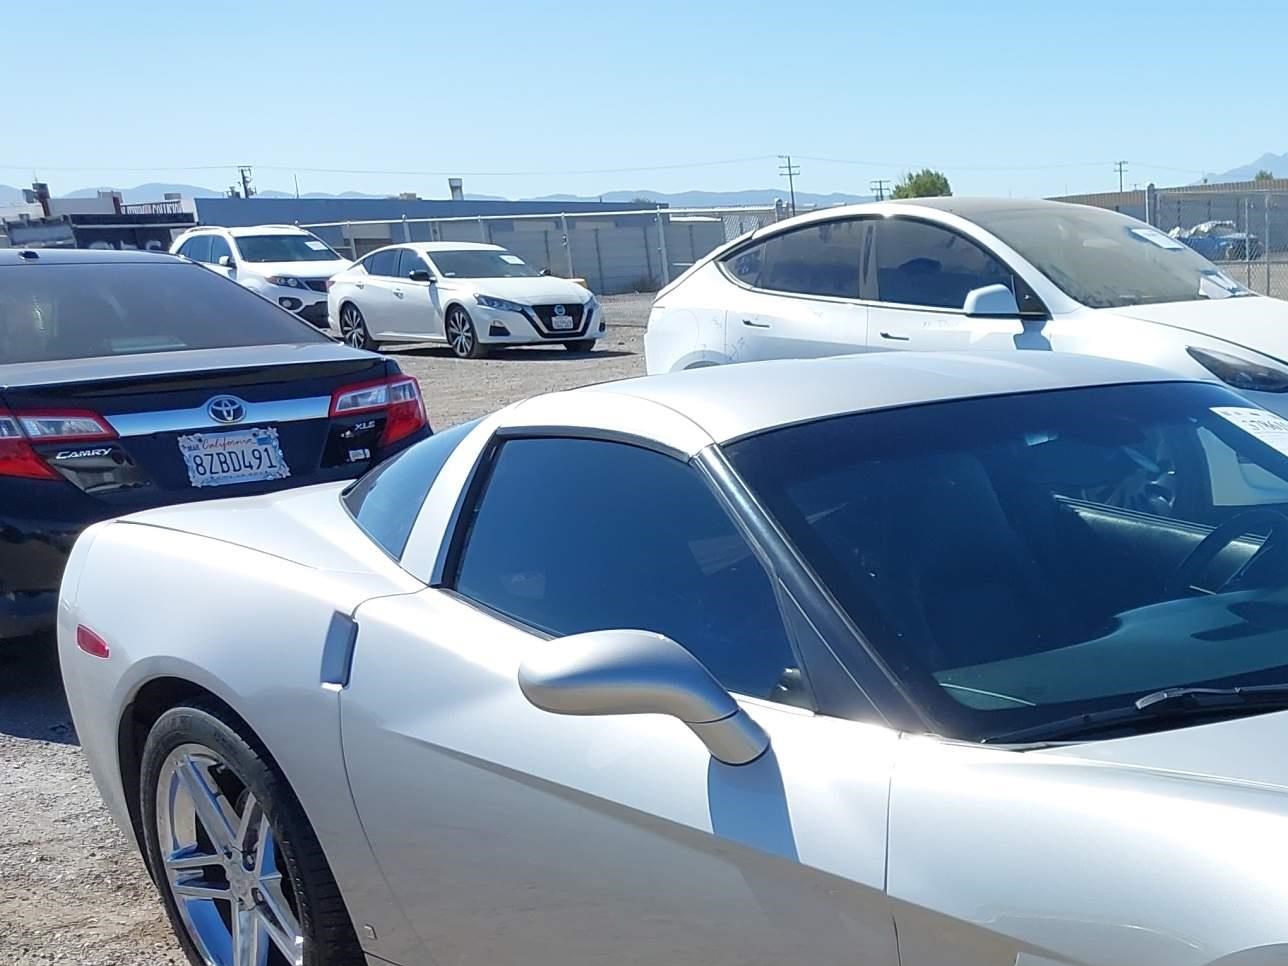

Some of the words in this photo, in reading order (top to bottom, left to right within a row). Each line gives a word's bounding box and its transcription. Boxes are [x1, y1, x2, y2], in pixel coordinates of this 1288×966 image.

[202, 437, 257, 451] California
[55, 447, 112, 460] CAMRY
[193, 447, 278, 477] 8ZBD491
